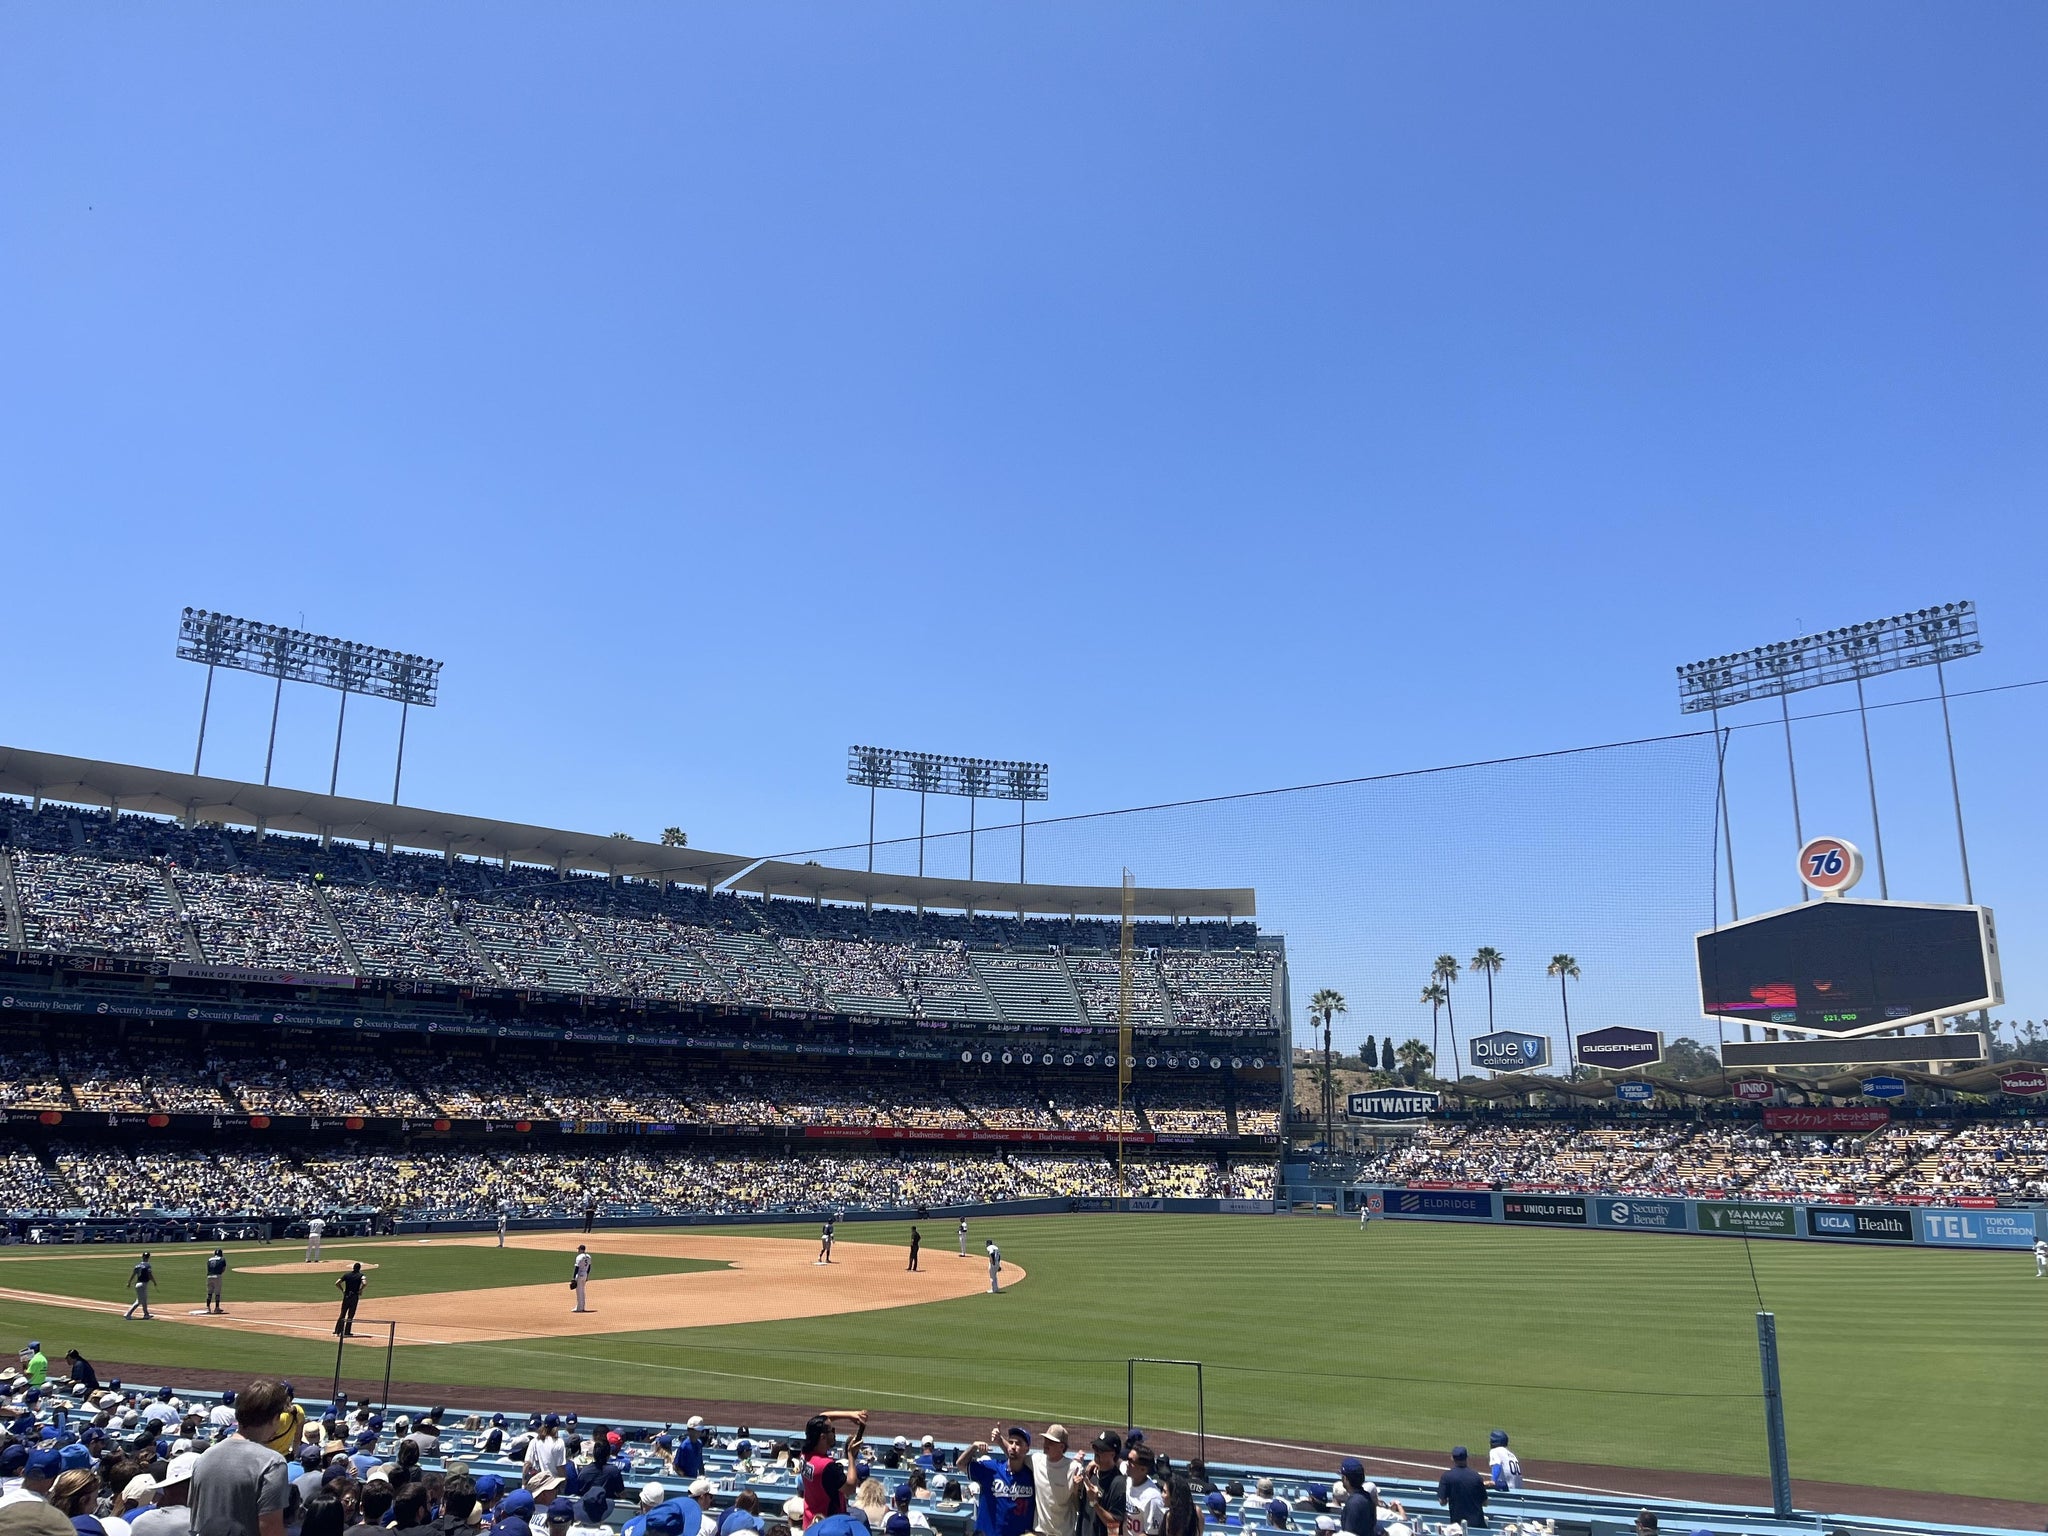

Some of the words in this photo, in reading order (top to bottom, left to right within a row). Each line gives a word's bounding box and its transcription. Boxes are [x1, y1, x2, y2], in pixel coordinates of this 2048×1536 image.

[1808, 848, 1844, 877] 76
[188, 969, 215, 978] BANK
[231, 973, 274, 982] AMERICA
[16, 999, 50, 1009] Security
[53, 1001, 83, 1011] Benefit
[110, 1005, 143, 1015] Security
[146, 1008, 173, 1017] Benefit
[200, 1011, 231, 1020] Security
[234, 1013, 261, 1021] Benefit
[284, 1016, 314, 1025] Security
[317, 1018, 342, 1026] Benefit
[364, 1020, 392, 1029] Security
[438, 1024, 464, 1033] Security
[466, 1026, 489, 1034] Benefit
[507, 1028, 532, 1037] Security
[574, 1032, 596, 1041] Security
[636, 1036, 657, 1044] Security
[695, 1039, 715, 1047] Security
[751, 1042, 770, 1050] Security
[1583, 1043, 1653, 1053] GUGGENHEIM
[1476, 1040, 1518, 1057] blue
[1065, 1056, 1073, 1064] 20
[1483, 1056, 1524, 1065] california
[2003, 1079, 2045, 1087] Yakult
[1739, 1083, 1767, 1095] JINRO
[1353, 1097, 1433, 1113] CUTWATER
[1777, 1113, 1826, 1126] マイケル
[973, 1132, 1009, 1140] Budweiser
[1039, 1132, 1076, 1140] Budweiser
[1370, 1199, 1381, 1209] 76
[1424, 1199, 1476, 1209] ELDRIDGE
[1632, 1202, 1670, 1215] Security
[1523, 1205, 1555, 1214] UNIQLO
[1557, 1205, 1583, 1215] FIELD
[1633, 1214, 1666, 1225] Benefit
[1820, 1216, 1851, 1228] UCLA
[1984, 1217, 2015, 1226] TOKYO
[1858, 1218, 1903, 1232] Health
[1925, 1216, 1977, 1238] TEL
[1987, 1227, 2032, 1236] ELECTRON
[992, 1478, 1034, 1501] Dodgers
[1013, 1499, 1027, 1516] 31
[1126, 1517, 1141, 1532] 50
